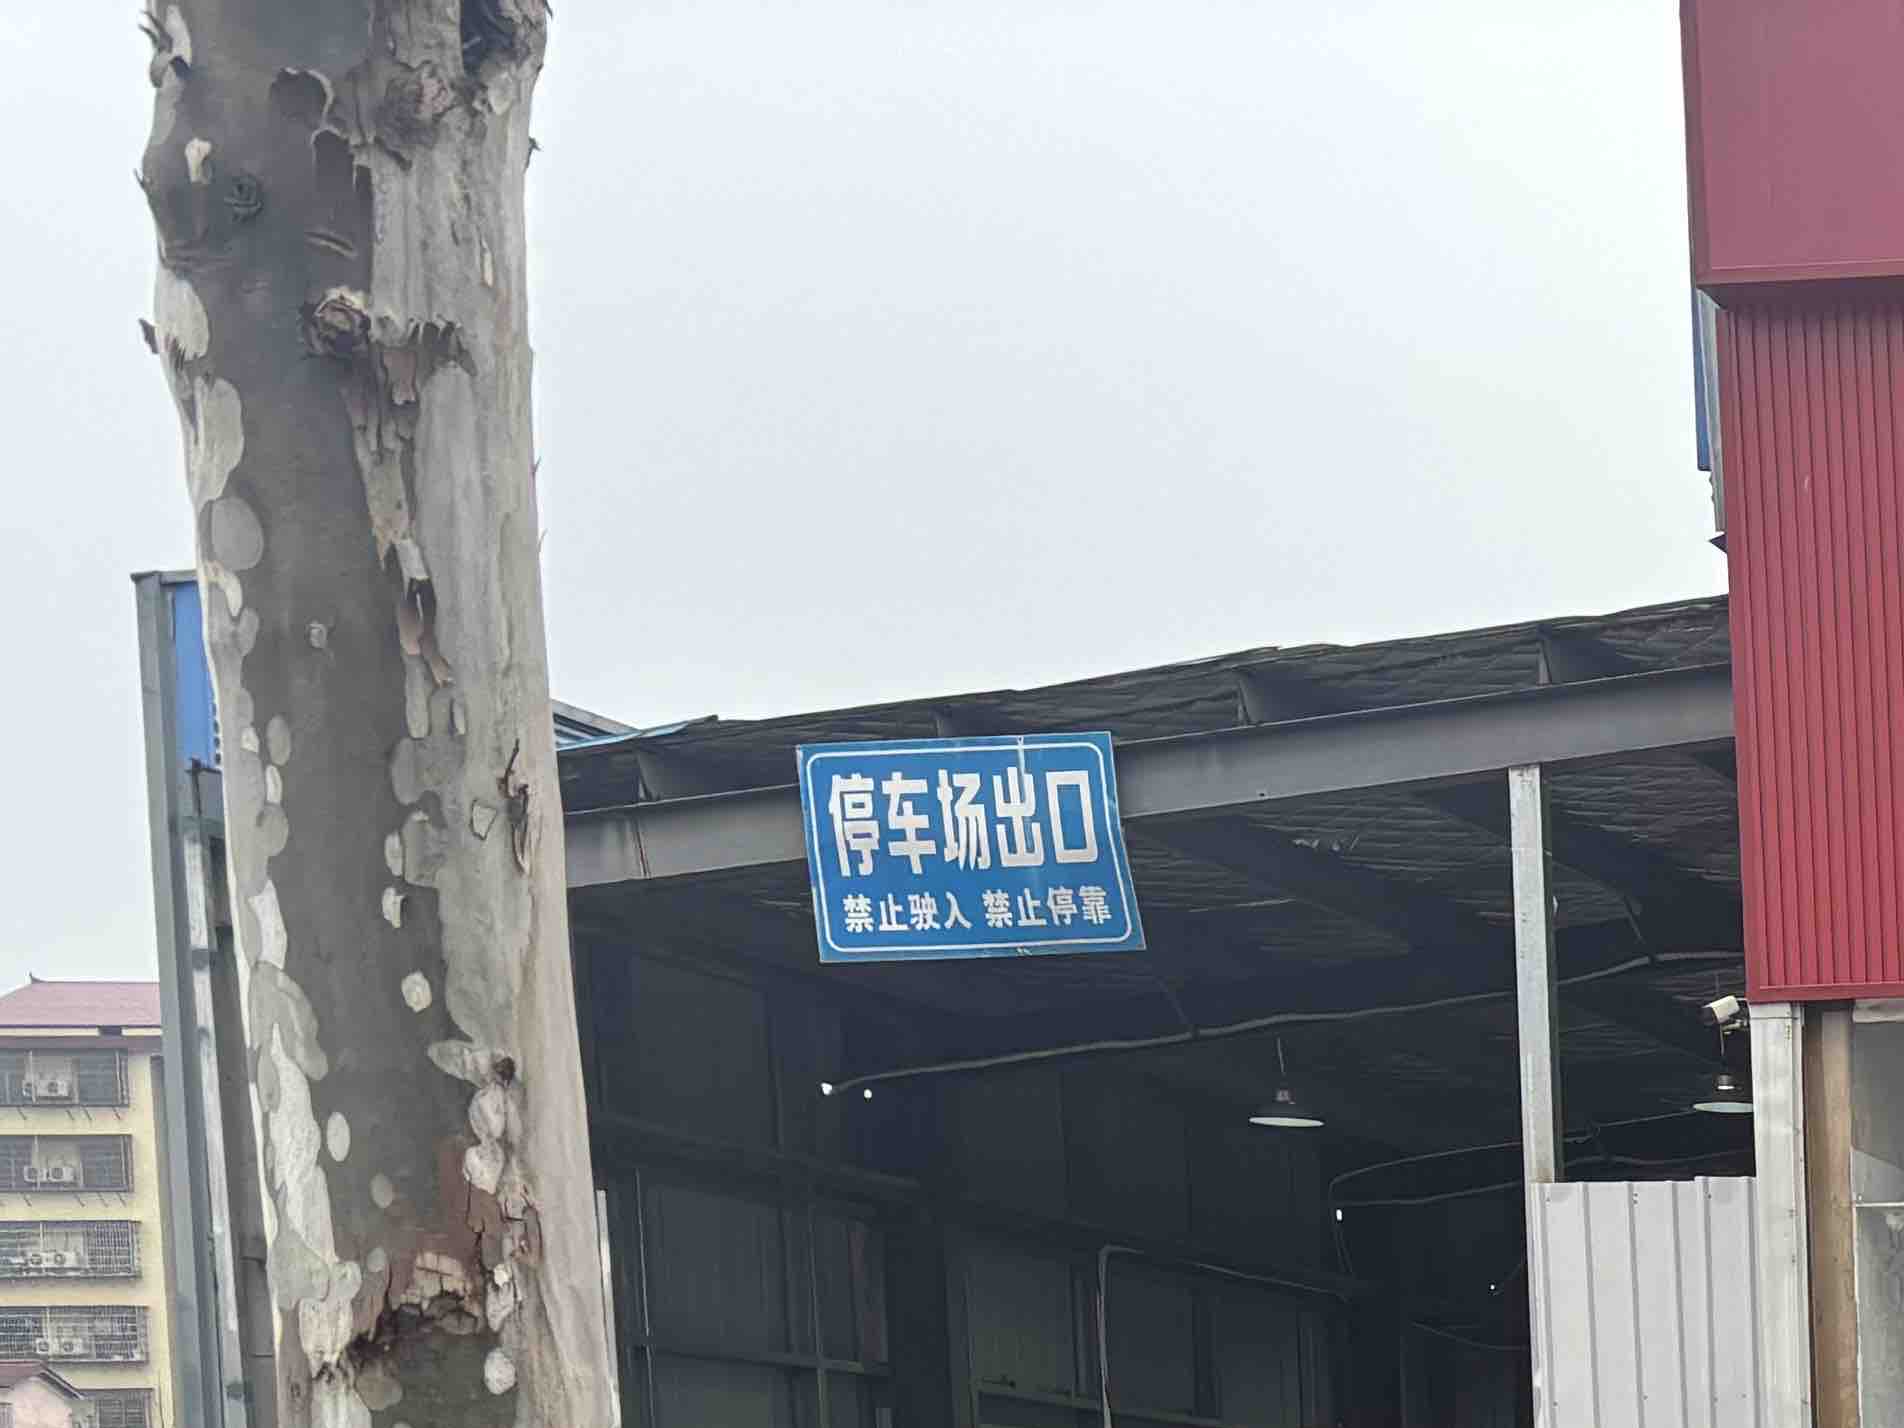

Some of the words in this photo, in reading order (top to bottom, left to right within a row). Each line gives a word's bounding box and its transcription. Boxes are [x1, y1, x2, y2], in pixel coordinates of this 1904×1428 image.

[828, 766, 1100, 877] 停车场出口
[842, 890, 973, 934] 禁止驶入
[981, 884, 1113, 929] 禁止停靠
